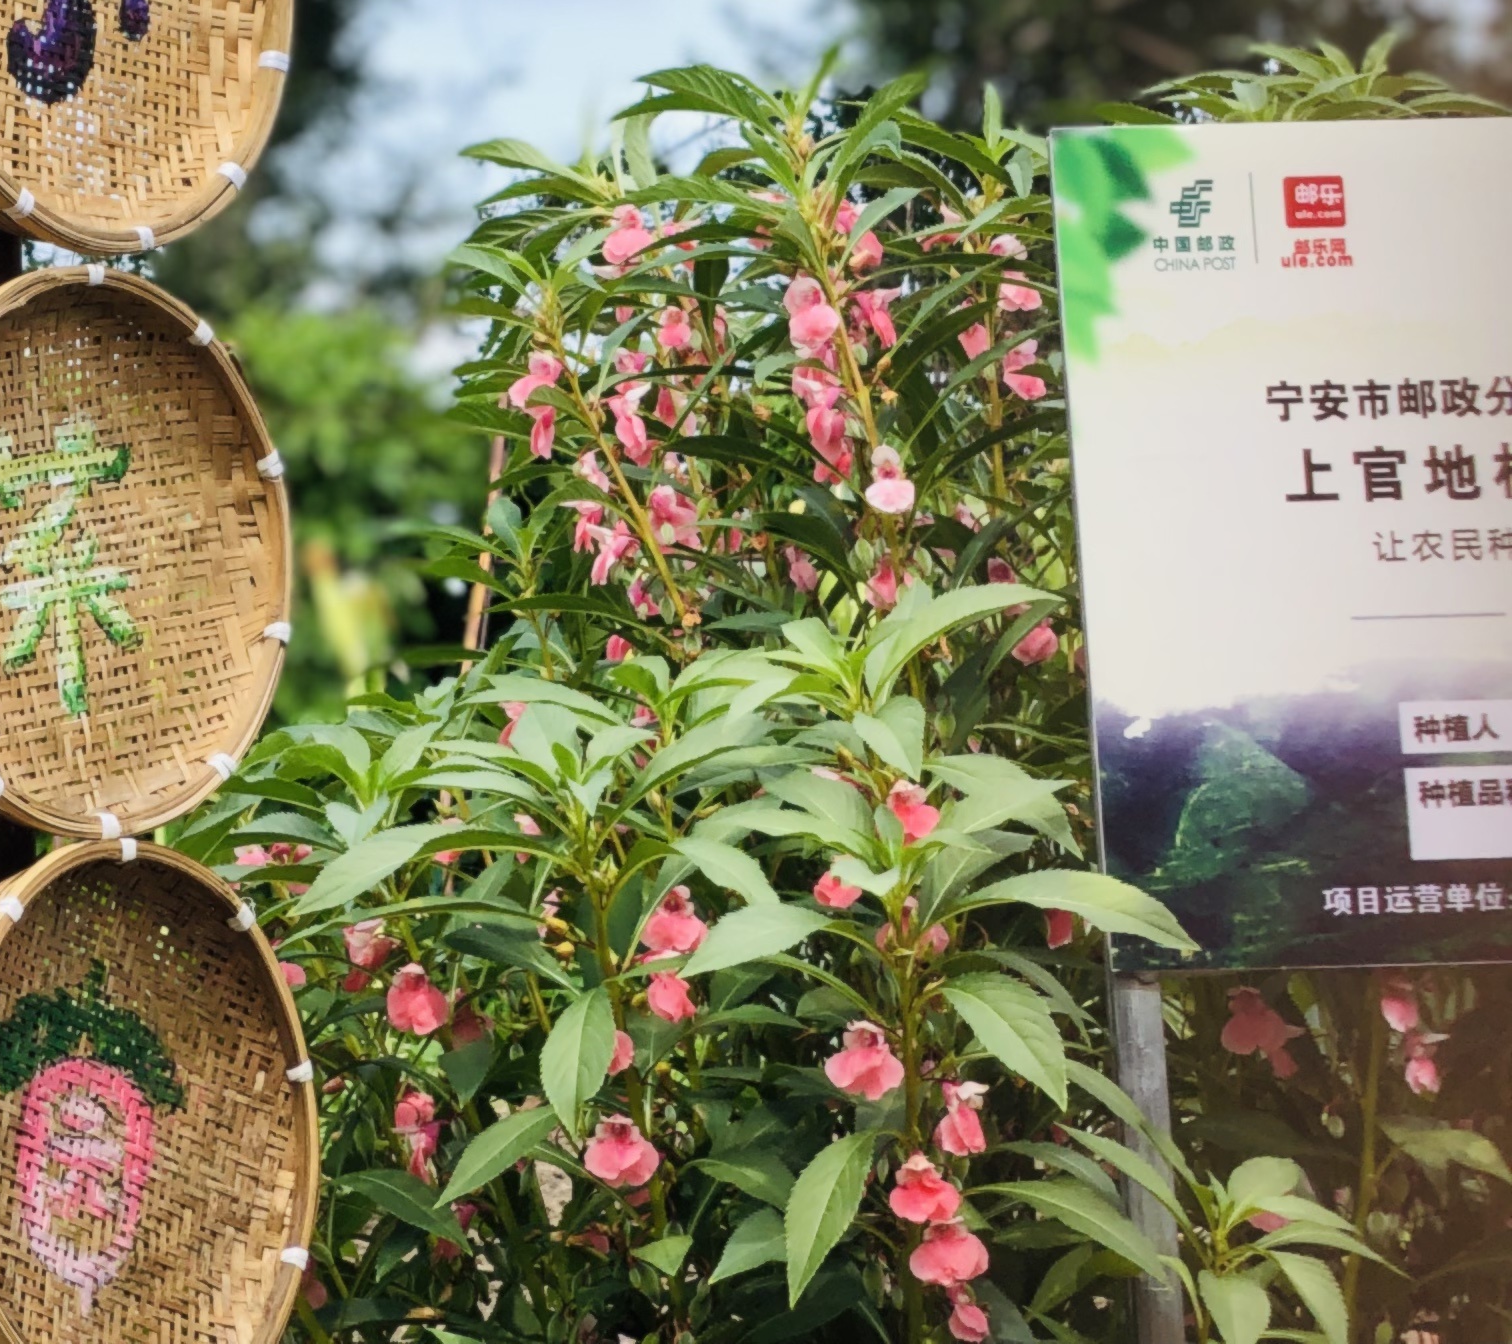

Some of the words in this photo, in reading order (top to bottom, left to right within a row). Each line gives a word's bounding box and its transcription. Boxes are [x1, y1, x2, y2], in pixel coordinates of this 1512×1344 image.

[1294, 209, 1342, 220] ule.com
[1152, 235, 1236, 254] 中国邮政
[1293, 238, 1347, 255] 邮乐网
[1154, 257, 1201, 272] CHINA
[1203, 256, 1236, 271] POST
[1280, 253, 1354, 269] ule.com
[1265, 376, 1512, 422] 宁安市邮政分
[1412, 713, 1500, 743] 种植人
